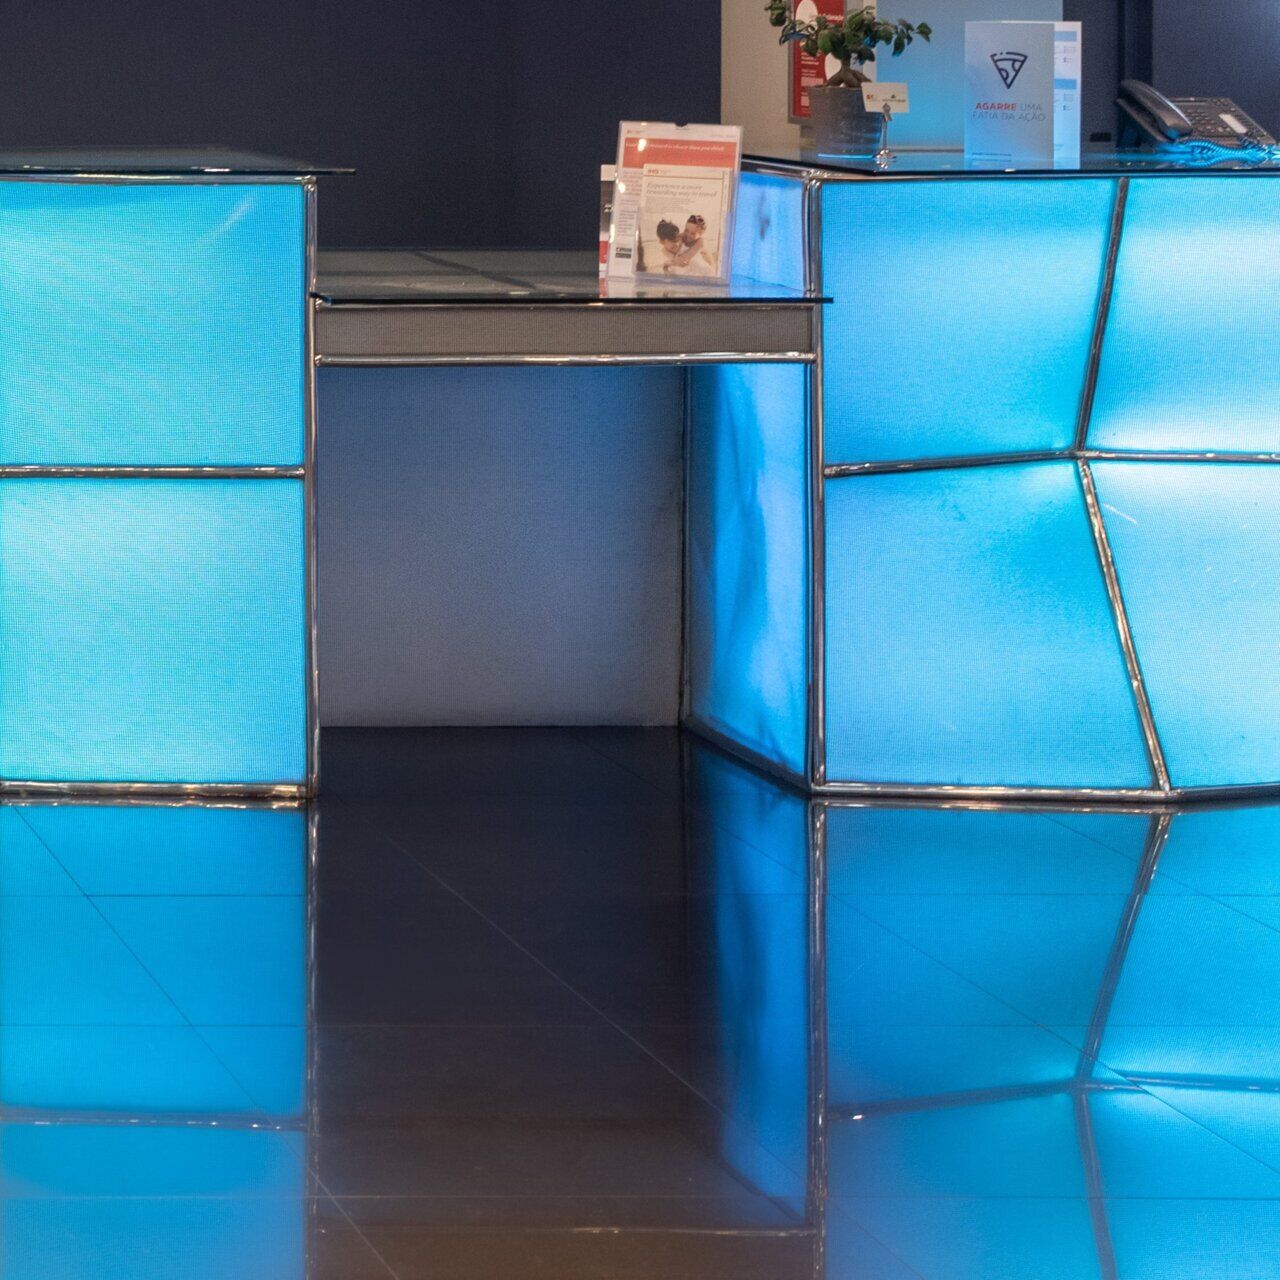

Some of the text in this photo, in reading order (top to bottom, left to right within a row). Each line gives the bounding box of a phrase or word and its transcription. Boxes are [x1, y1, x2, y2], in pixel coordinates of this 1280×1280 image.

[975, 102, 1042, 111] AGARRE UMA
[972, 111, 1046, 122] FATIA DA AÇÃO
